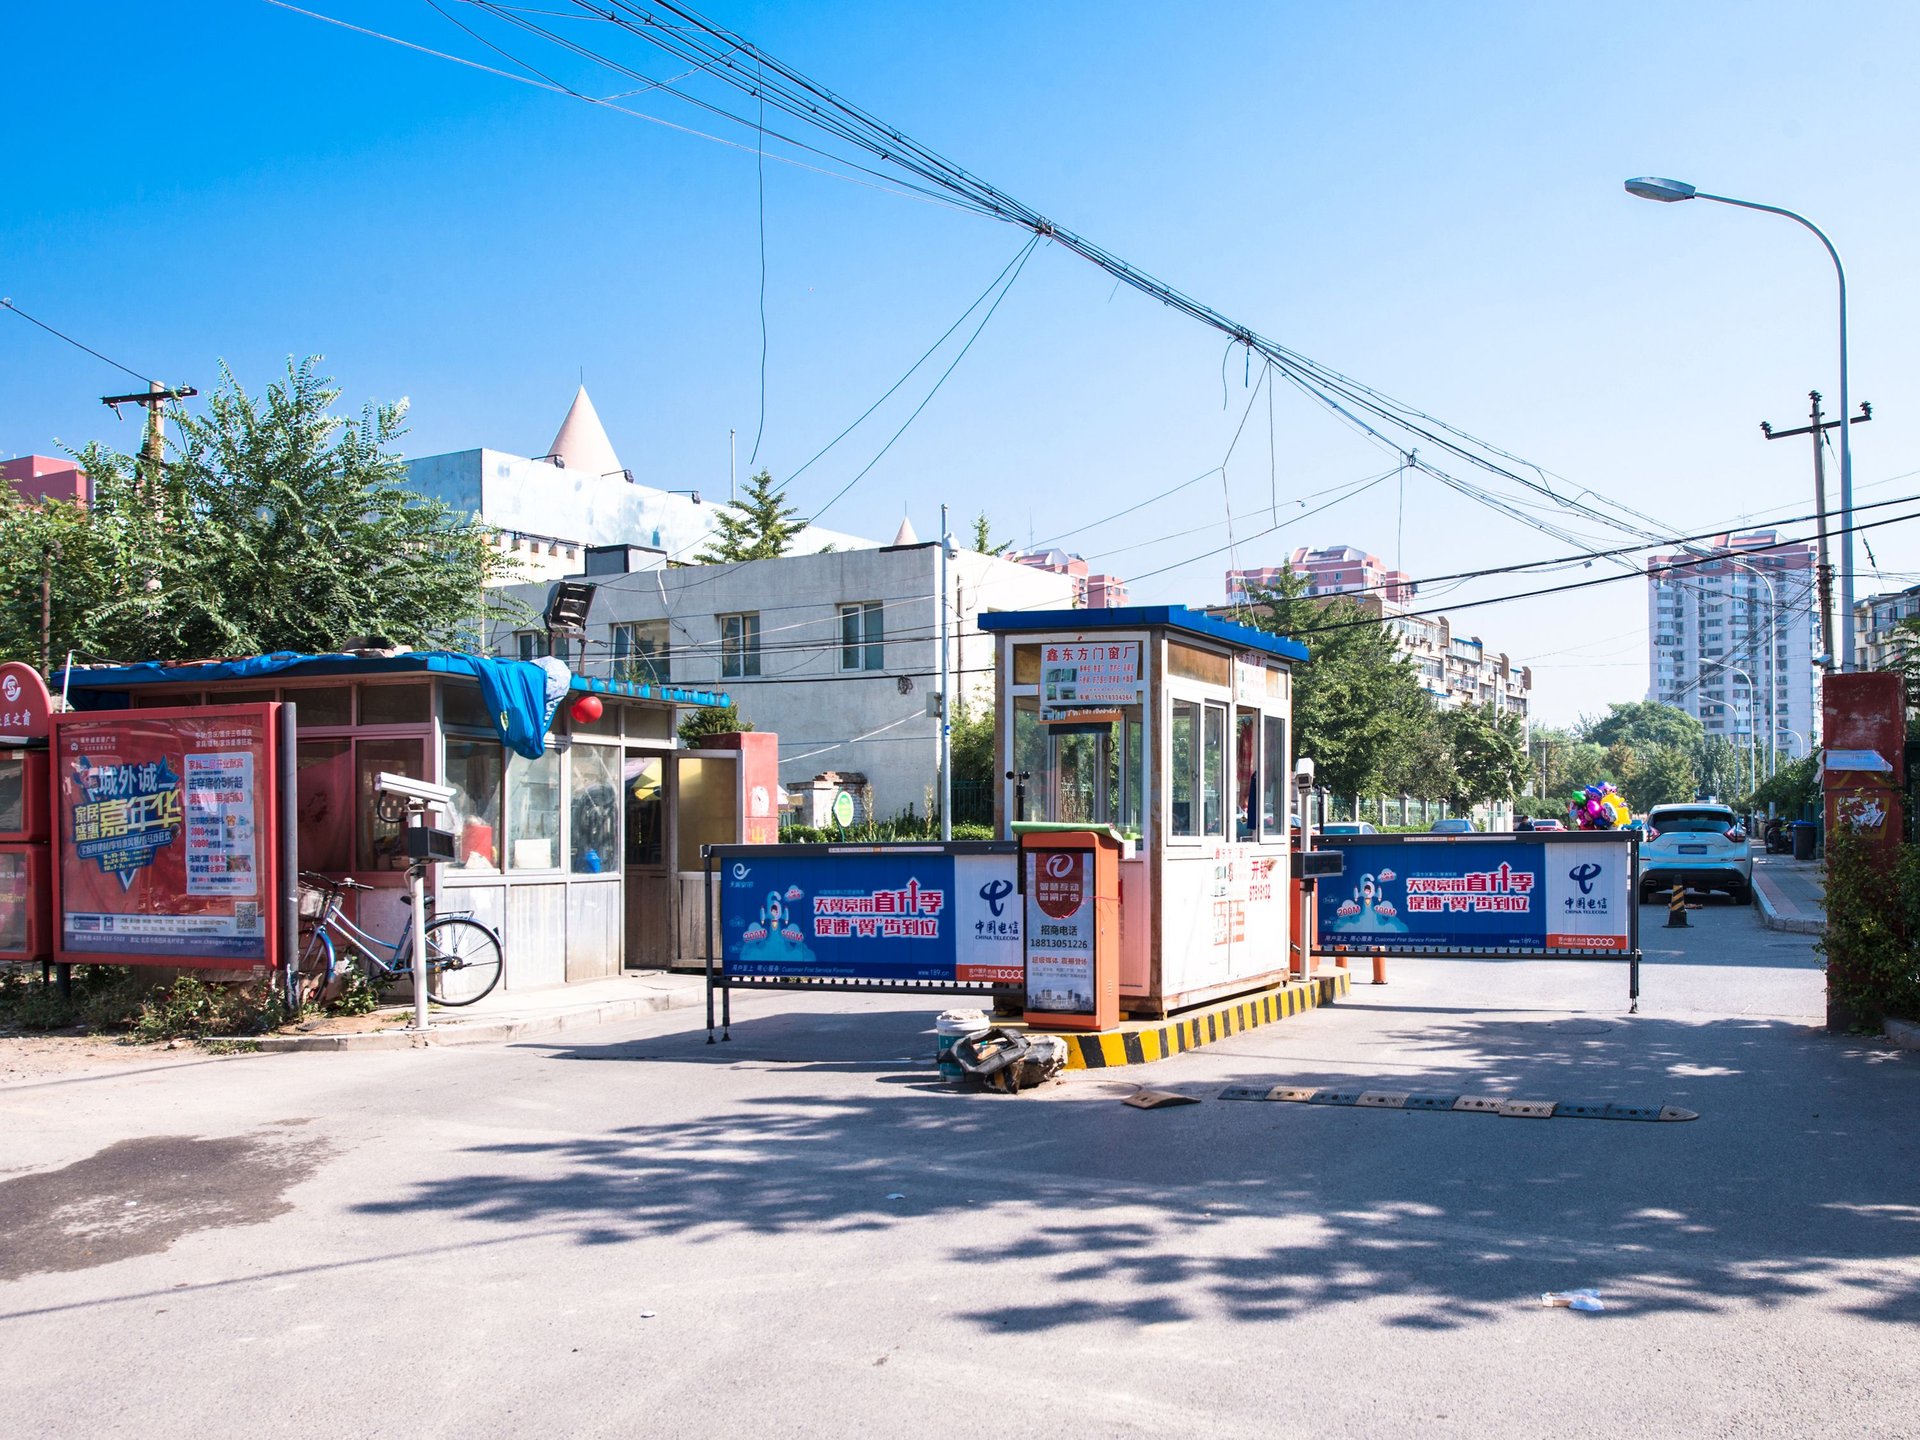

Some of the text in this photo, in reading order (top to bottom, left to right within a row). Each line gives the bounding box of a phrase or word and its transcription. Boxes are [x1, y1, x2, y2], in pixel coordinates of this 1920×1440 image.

[1047, 646, 1135, 661] 鑫东方门窗厂
[99, 762, 157, 796] 城外诚
[100, 788, 182, 838] 嘉年华
[1408, 863, 1532, 892] 天翼宽带直升季
[815, 880, 943, 914] 天翼宽带直升季
[1408, 896, 1528, 911] 提速“翼”步到位
[1565, 897, 1607, 909] 中国电信
[1338, 906, 1361, 917] 200M
[1375, 906, 1396, 916] 100M
[815, 917, 937, 937] 提速“翼”步到位
[975, 919, 1019, 935] 中国电信
[1041, 925, 1078, 936] 招商电话
[1030, 938, 1088, 949] 18813051226
